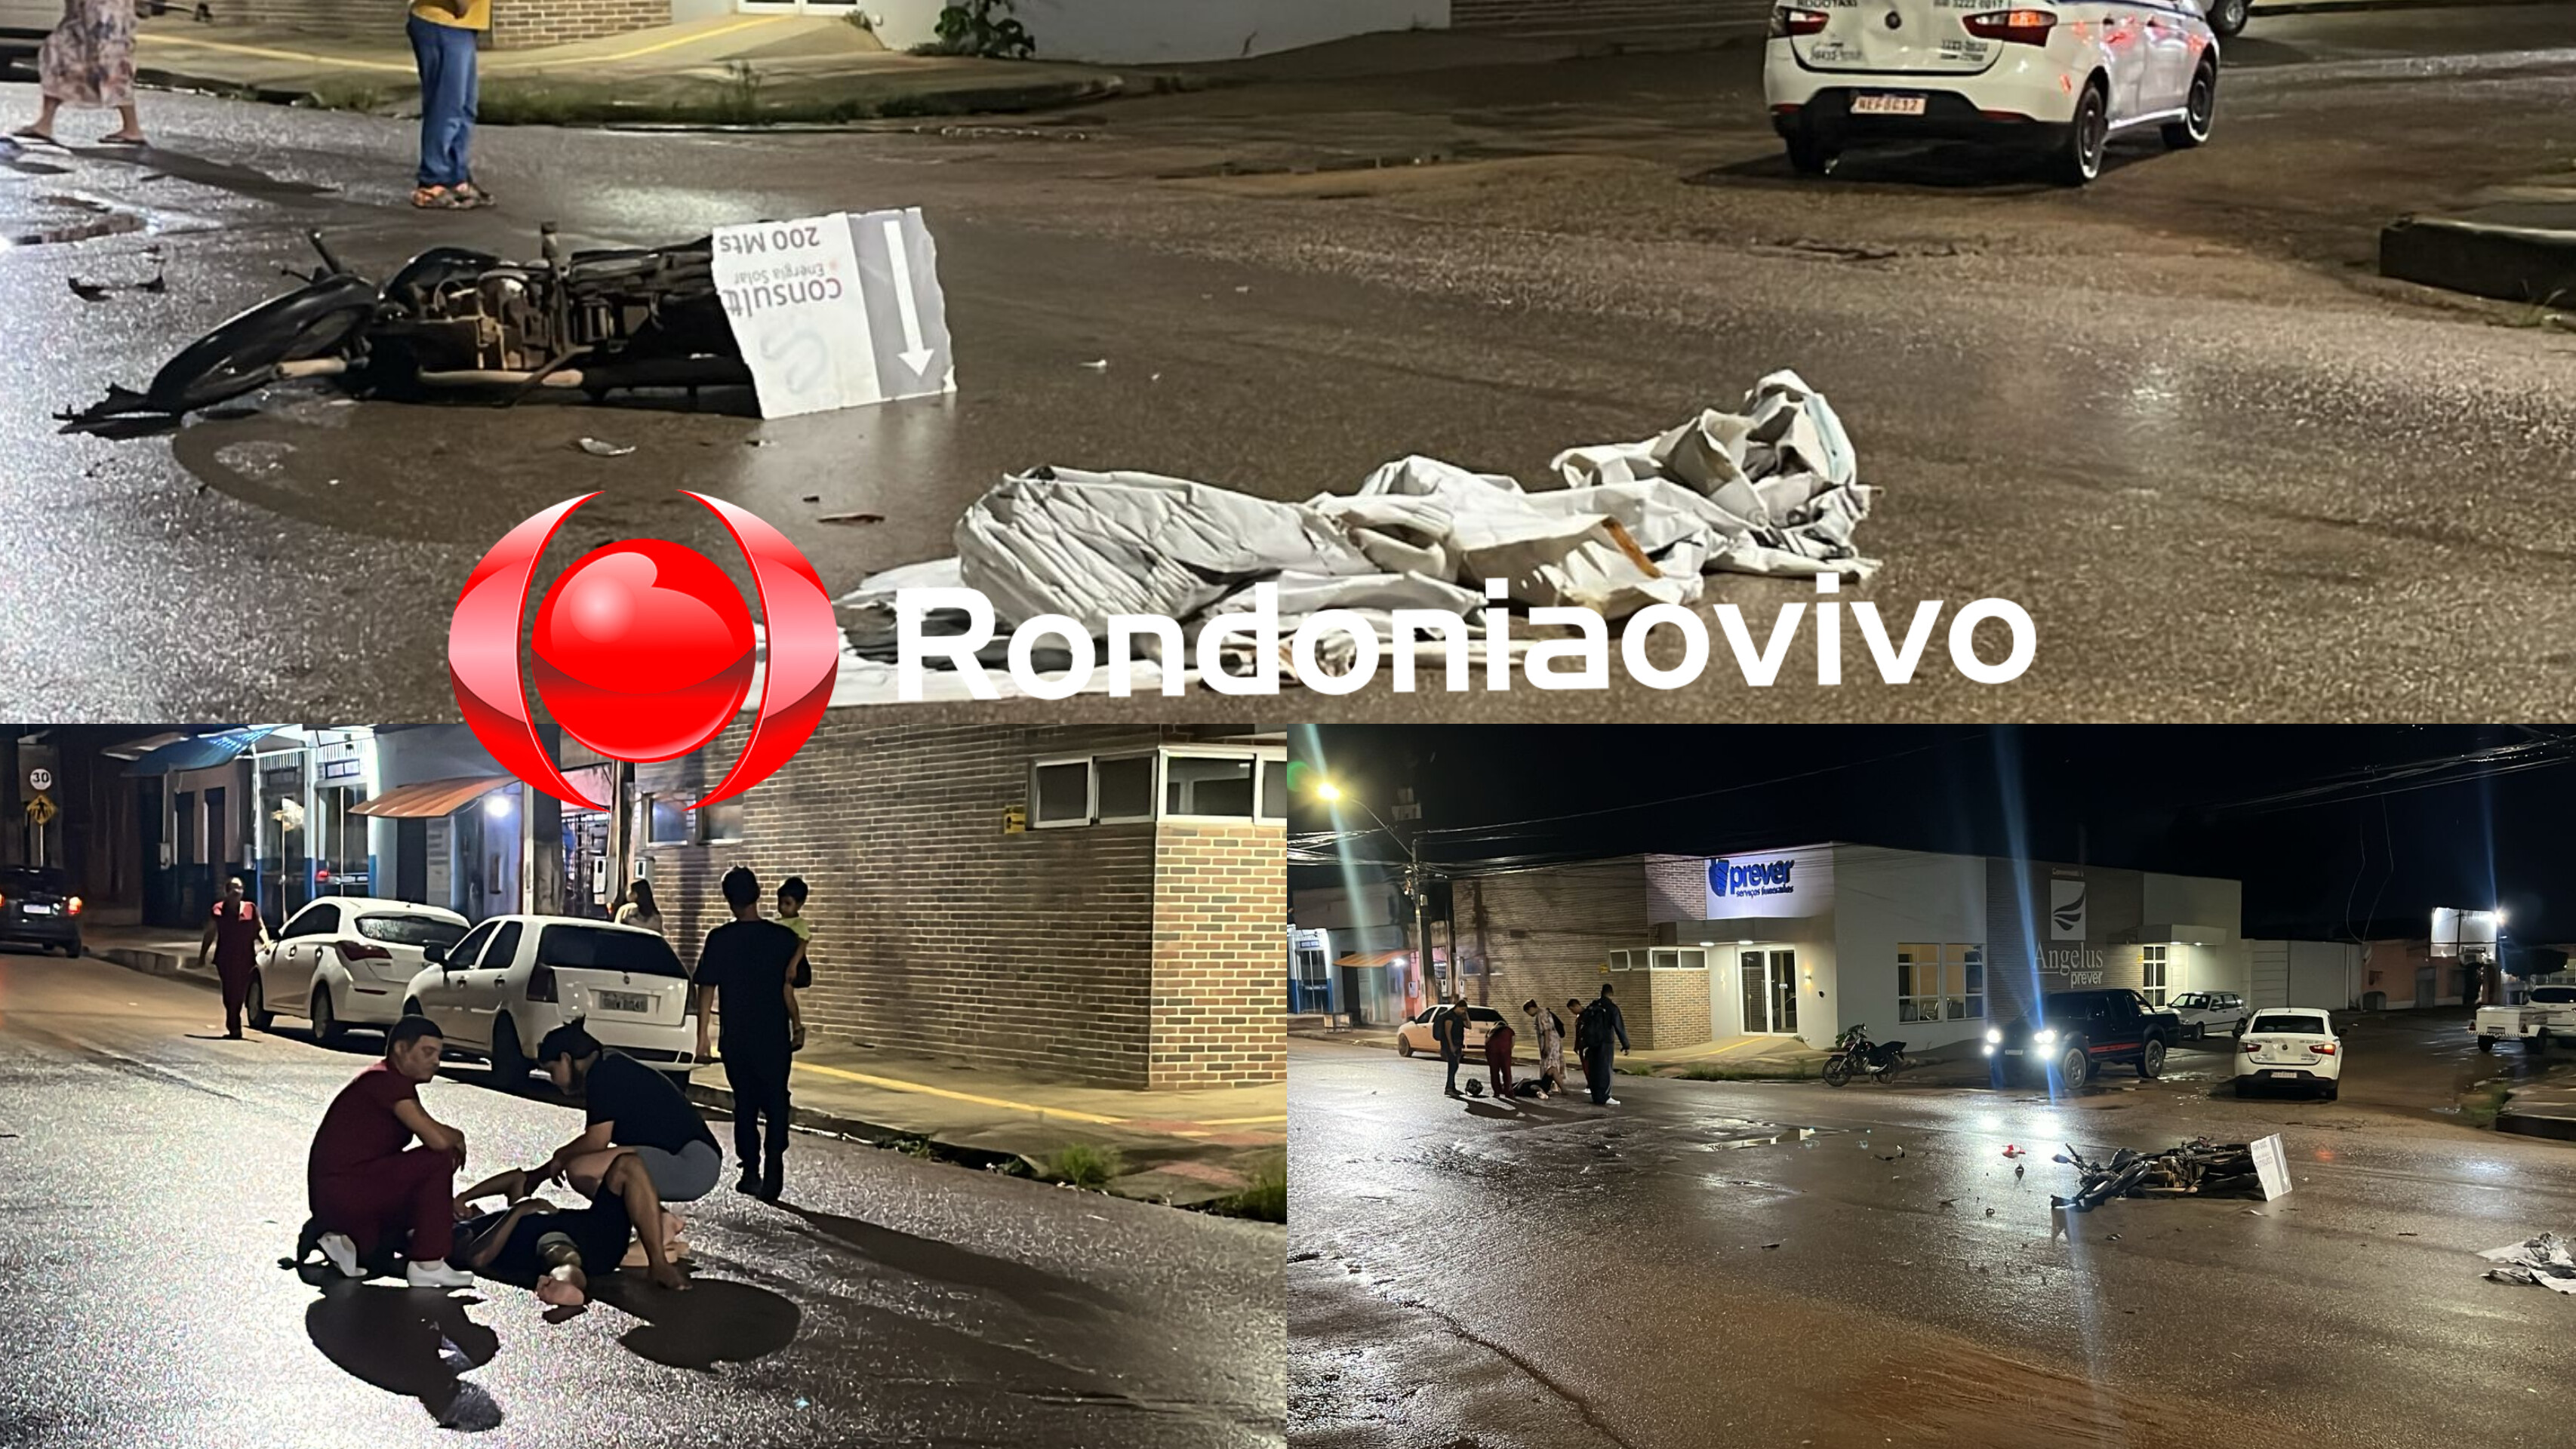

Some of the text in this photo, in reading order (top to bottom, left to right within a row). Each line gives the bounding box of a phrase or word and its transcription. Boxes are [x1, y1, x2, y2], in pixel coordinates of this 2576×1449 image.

[719, 227, 820, 255] 200 Mts
[734, 263, 824, 285] Energia Solar
[32, 772, 49, 783] 30
[1730, 860, 1795, 895] prever
[2033, 941, 2104, 976] Angelus
[2071, 971, 2102, 988] prever
